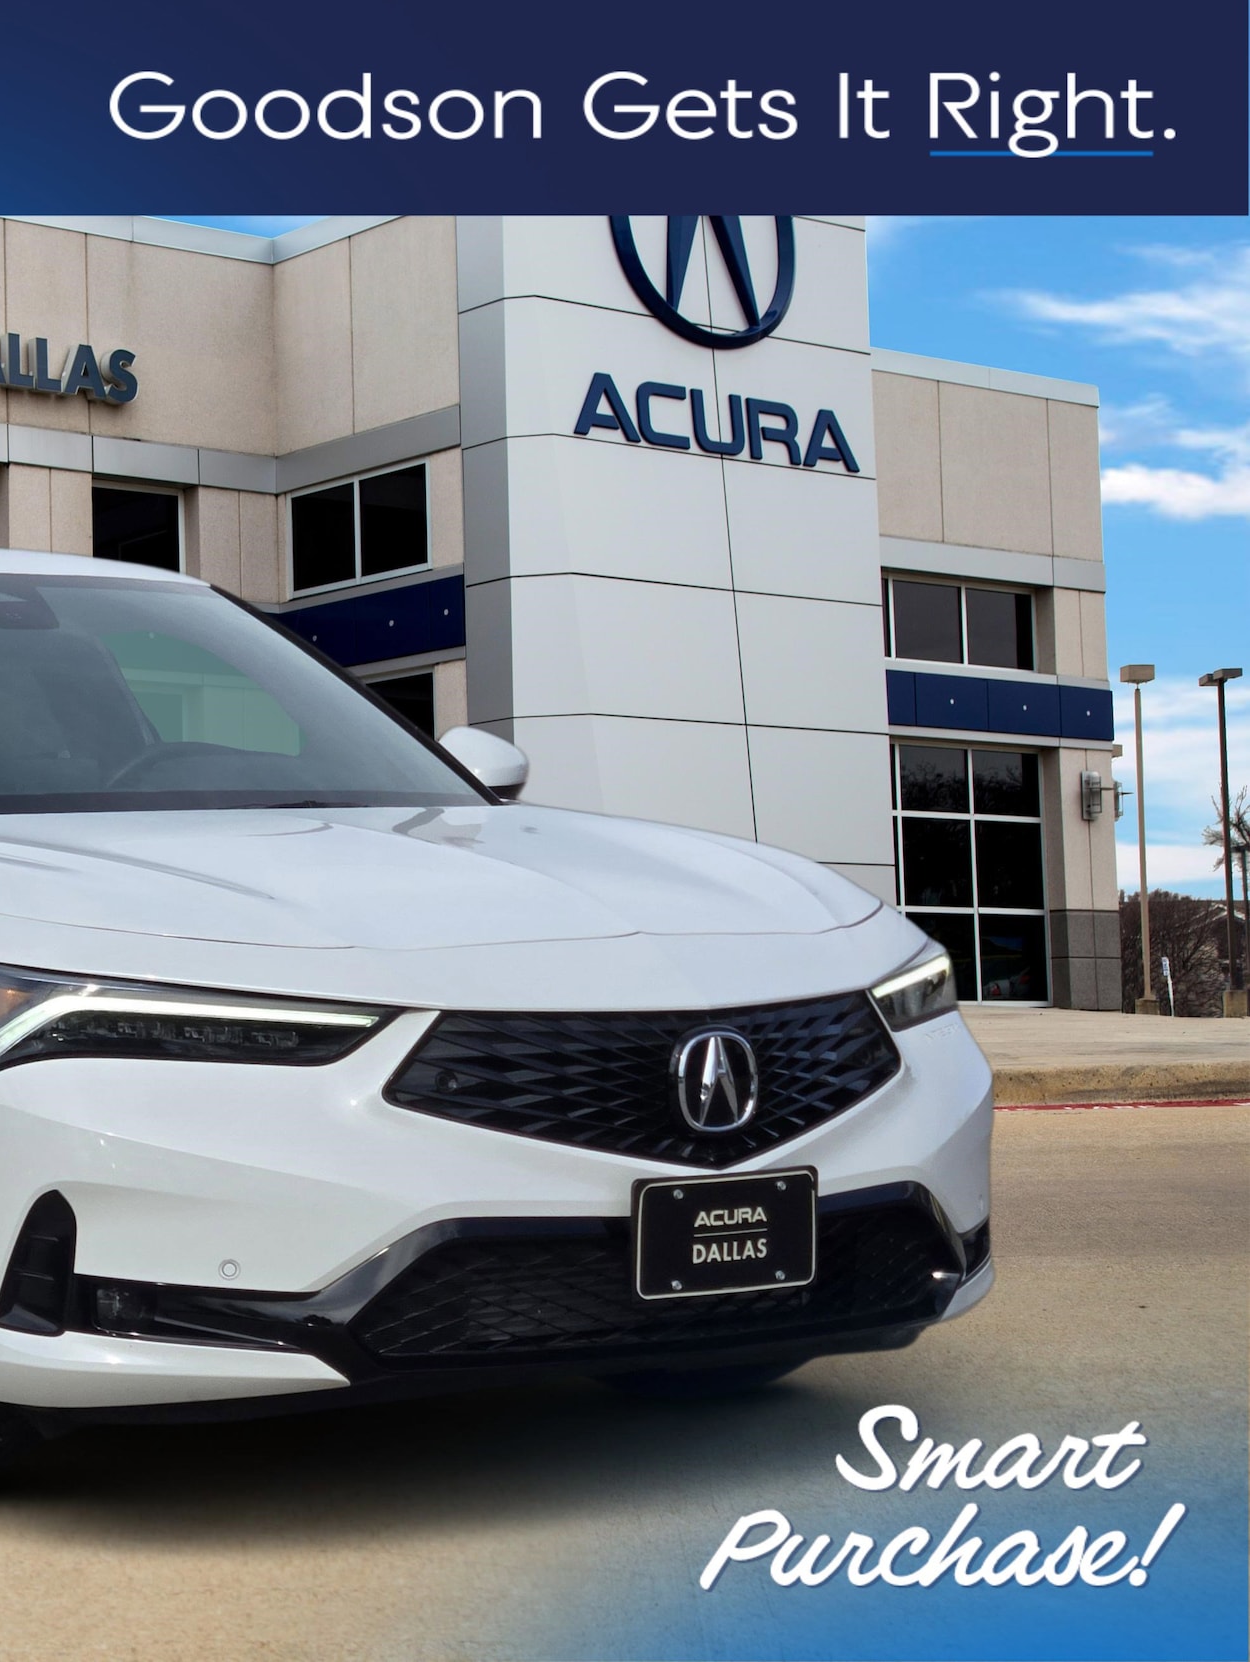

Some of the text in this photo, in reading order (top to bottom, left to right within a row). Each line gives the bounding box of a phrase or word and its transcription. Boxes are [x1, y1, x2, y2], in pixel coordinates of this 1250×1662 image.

[573, 372, 860, 473] ACURA
[694, 1206, 767, 1228] ACURA
[692, 1238, 767, 1264] DALLAS
